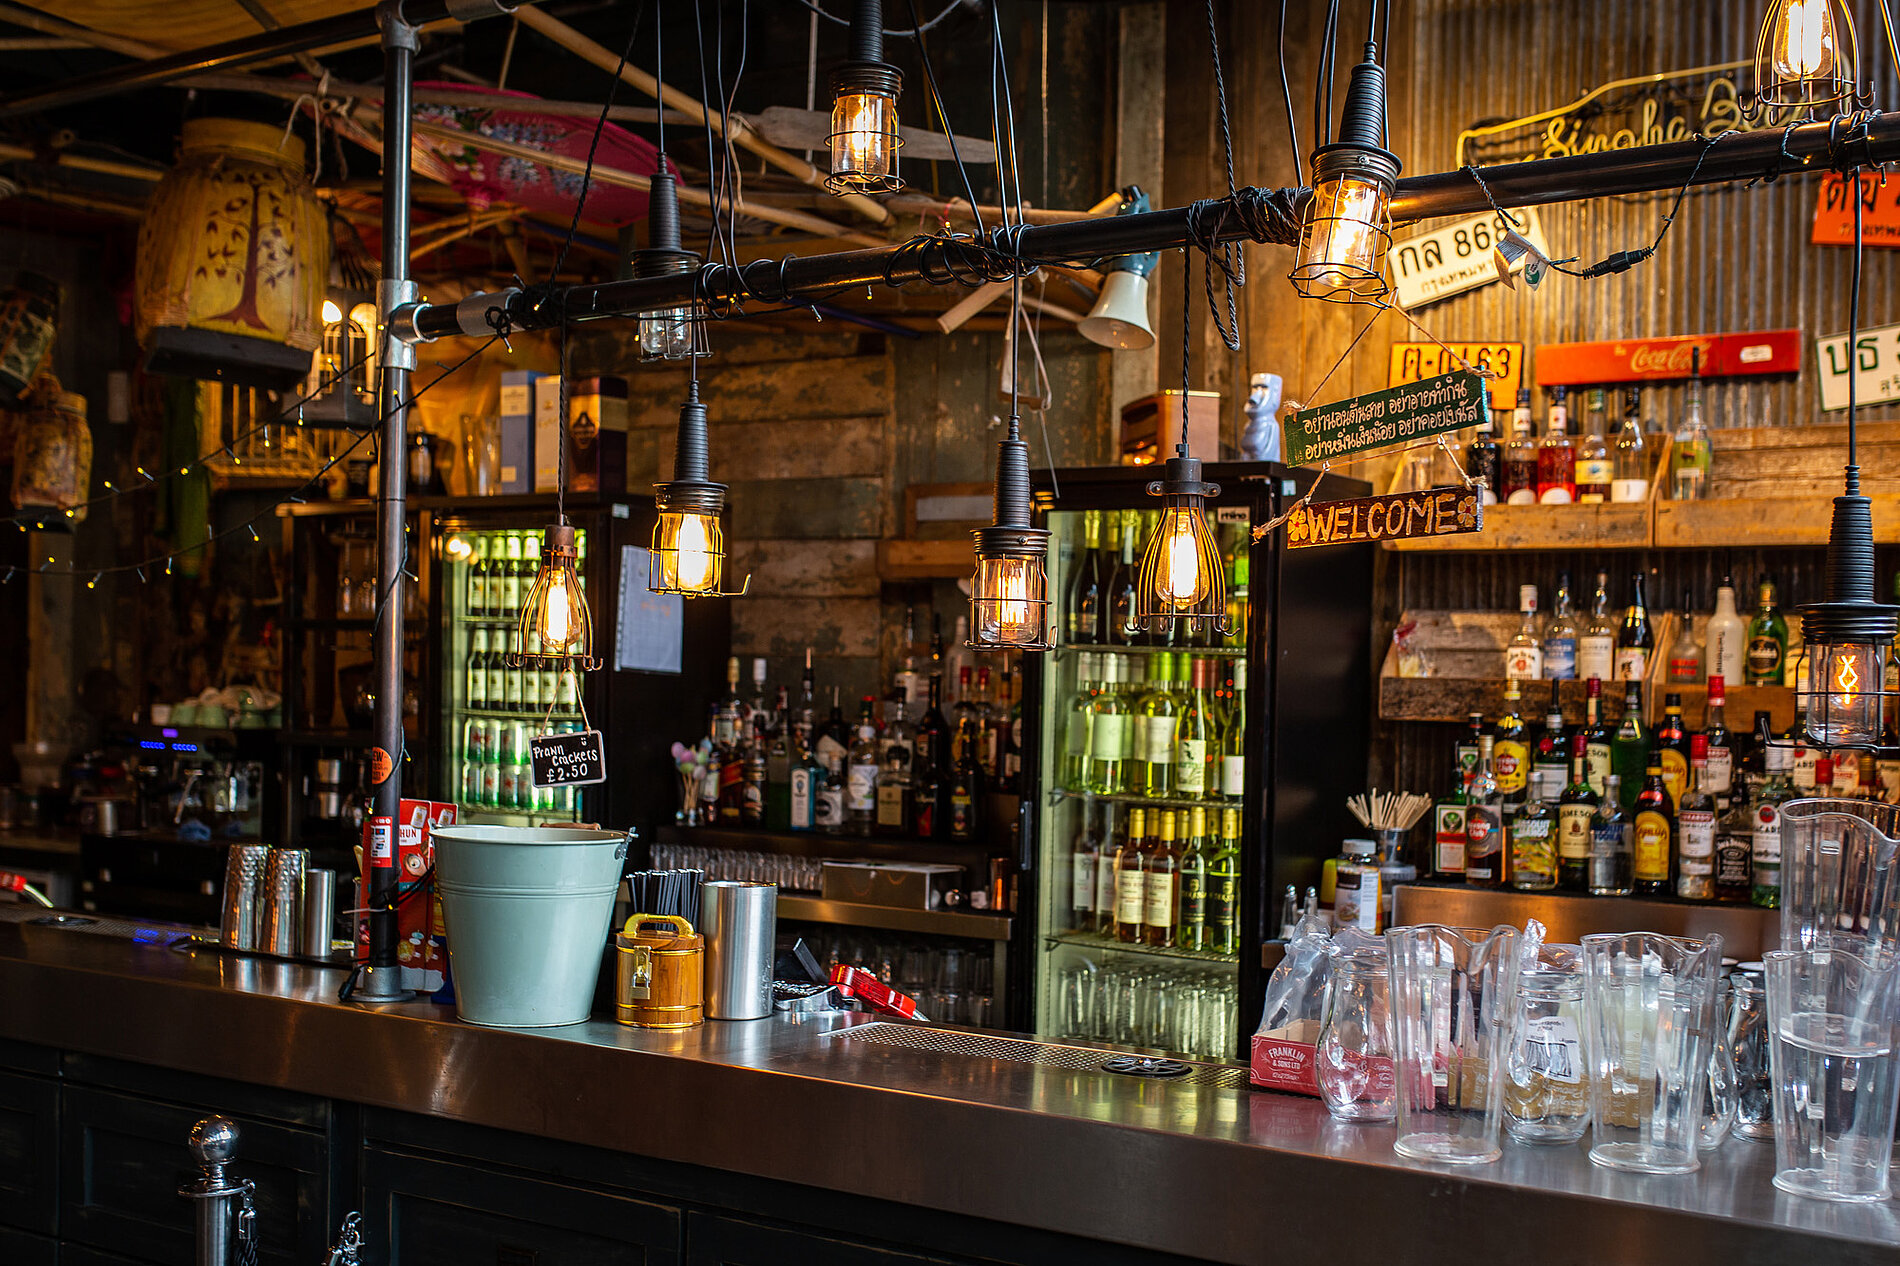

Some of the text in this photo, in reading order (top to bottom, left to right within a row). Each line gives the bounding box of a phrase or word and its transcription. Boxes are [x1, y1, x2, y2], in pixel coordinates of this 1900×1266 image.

[1307, 493, 1458, 543] WELCOME
[546, 763, 589, 784] £2.50
[1268, 1046, 1306, 1063] FRANKLIN
